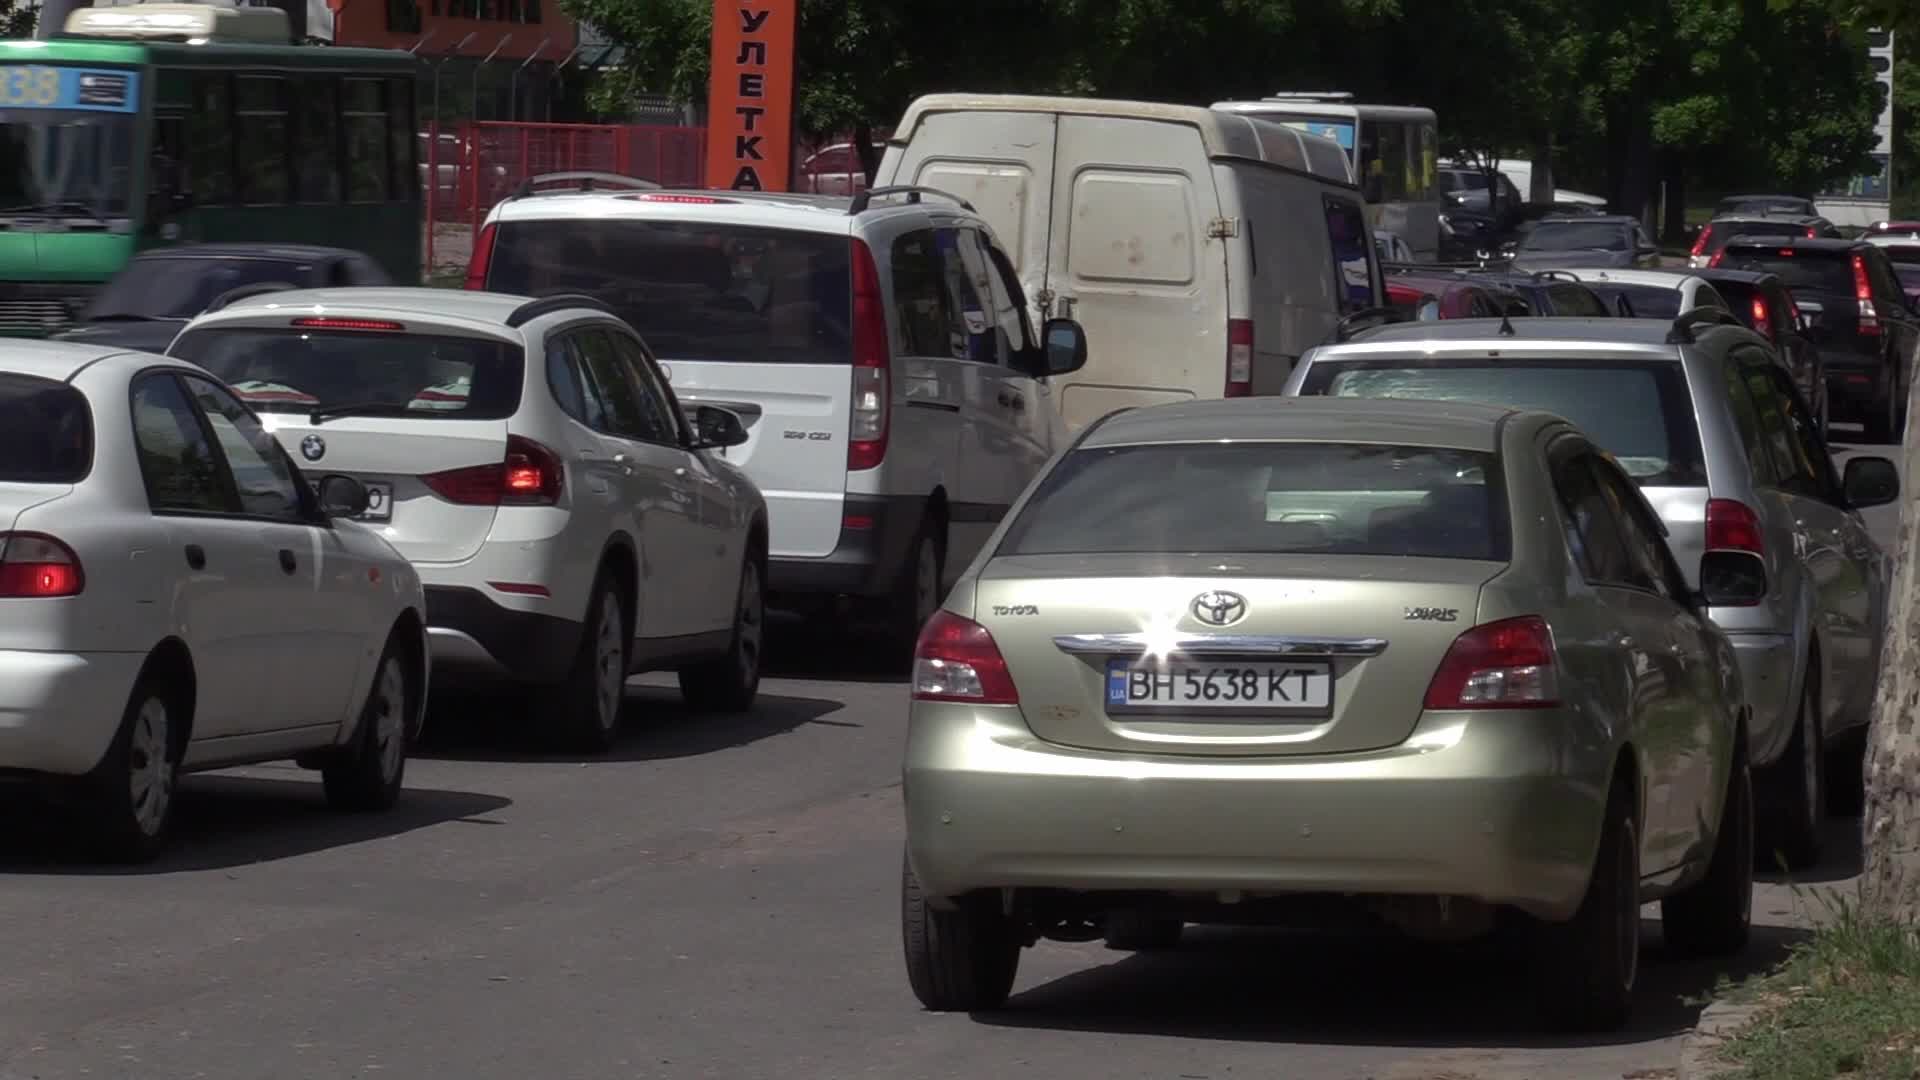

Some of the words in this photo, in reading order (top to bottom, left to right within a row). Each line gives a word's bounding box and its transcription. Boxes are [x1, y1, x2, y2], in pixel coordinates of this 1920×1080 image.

[731, 2, 769, 192] УЛЕТКА
[991, 604, 1040, 617] TOYOTA
[1111, 690, 1126, 700] UA
[1129, 669, 1175, 701] BH
[1184, 669, 1259, 701] 5638
[1268, 669, 1316, 701] KT
